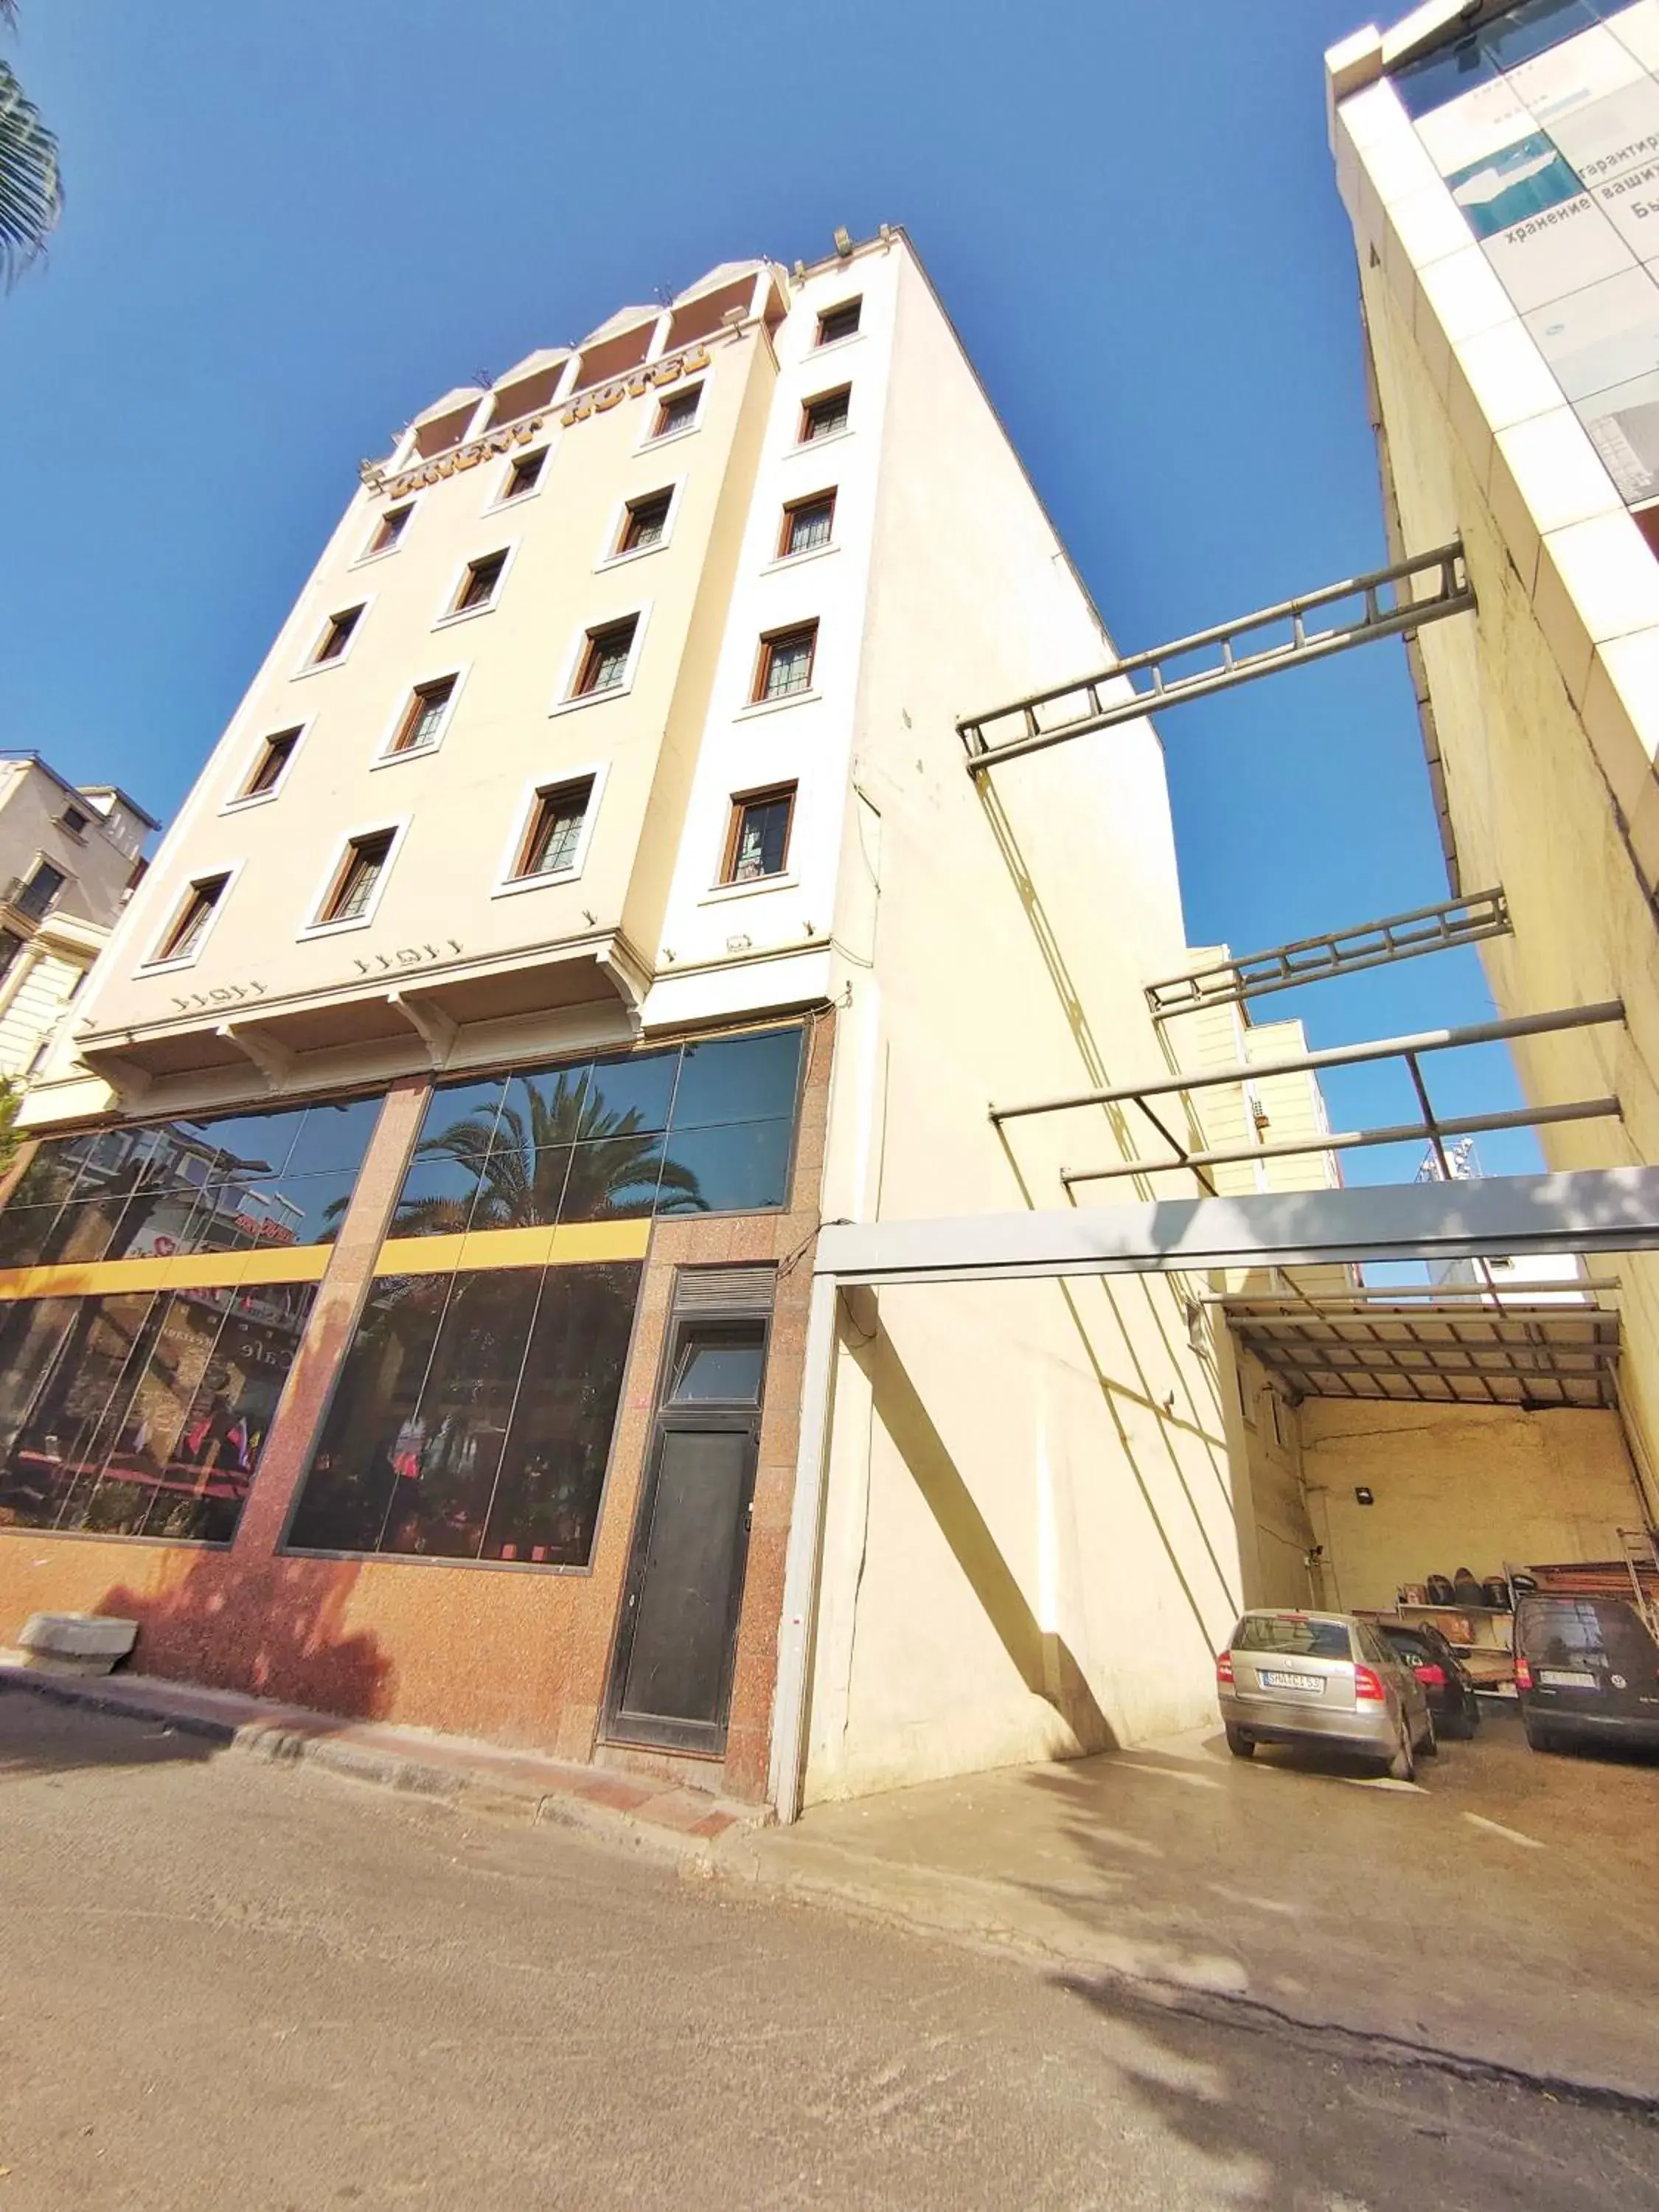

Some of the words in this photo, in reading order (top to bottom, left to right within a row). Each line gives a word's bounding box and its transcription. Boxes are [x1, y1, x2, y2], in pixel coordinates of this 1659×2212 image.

[1578, 133, 1659, 179] гарантир
[1505, 198, 1591, 243] хранение
[560, 343, 712, 428] HOTEL
